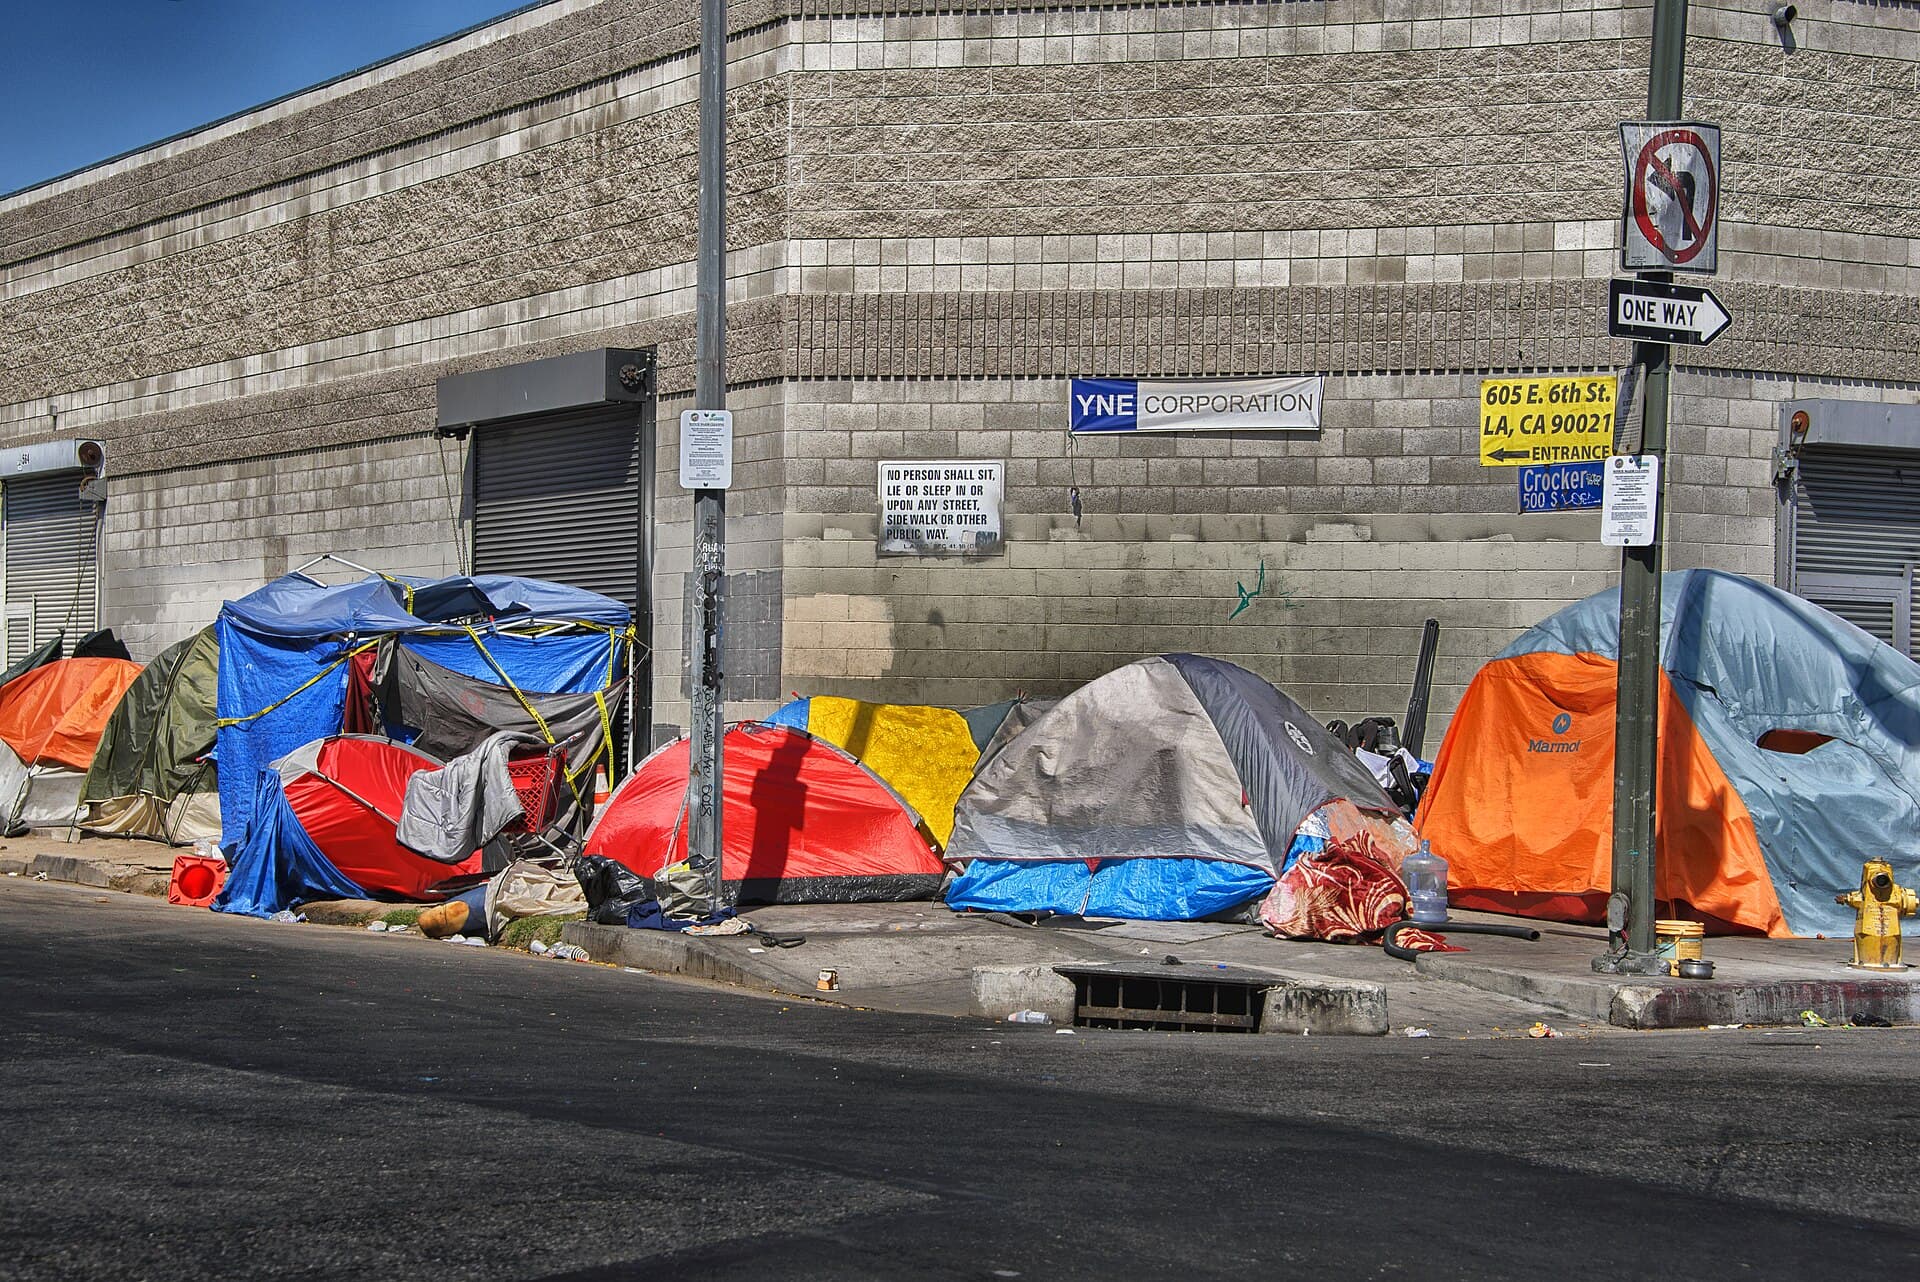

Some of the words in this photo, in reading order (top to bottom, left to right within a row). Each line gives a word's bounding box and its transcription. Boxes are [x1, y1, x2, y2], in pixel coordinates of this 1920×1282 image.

[1622, 298, 1657, 322] ONE
[1662, 302, 1697, 326] WAY
[1485, 385, 1522, 405] 605
[1526, 384, 1543, 404] E.
[1549, 382, 1581, 404] 6th
[1585, 382, 1611, 403] St.
[1076, 394, 1134, 416] YNE
[1144, 393, 1313, 414] CORPORATION
[1483, 415, 1514, 438] LA,
[1519, 414, 1546, 435] CA
[1551, 413, 1612, 434] 90021
[1532, 445, 1610, 461] ENTRANCE
[887, 469, 900, 481] NO
[903, 469, 941, 481] PERSON
[943, 469, 975, 481] SHALL
[977, 469, 996, 482] SIT,
[1523, 467, 1588, 492] Crocker
[887, 485, 901, 496] LIE
[905, 485, 919, 496] OR
[922, 485, 951, 496] SLEEP
[956, 485, 966, 496] IN
[970, 485, 983, 496] OR
[887, 500, 913, 511] UPON
[917, 500, 938, 511] ANY
[942, 500, 980, 512] STREET,
[1523, 493, 1545, 509] 500
[1550, 492, 1558, 507] S
[941, 514, 953, 525] OR
[956, 514, 987, 525] OTHER
[886, 529, 921, 540] PUBLIC
[926, 529, 949, 540] WAY.
